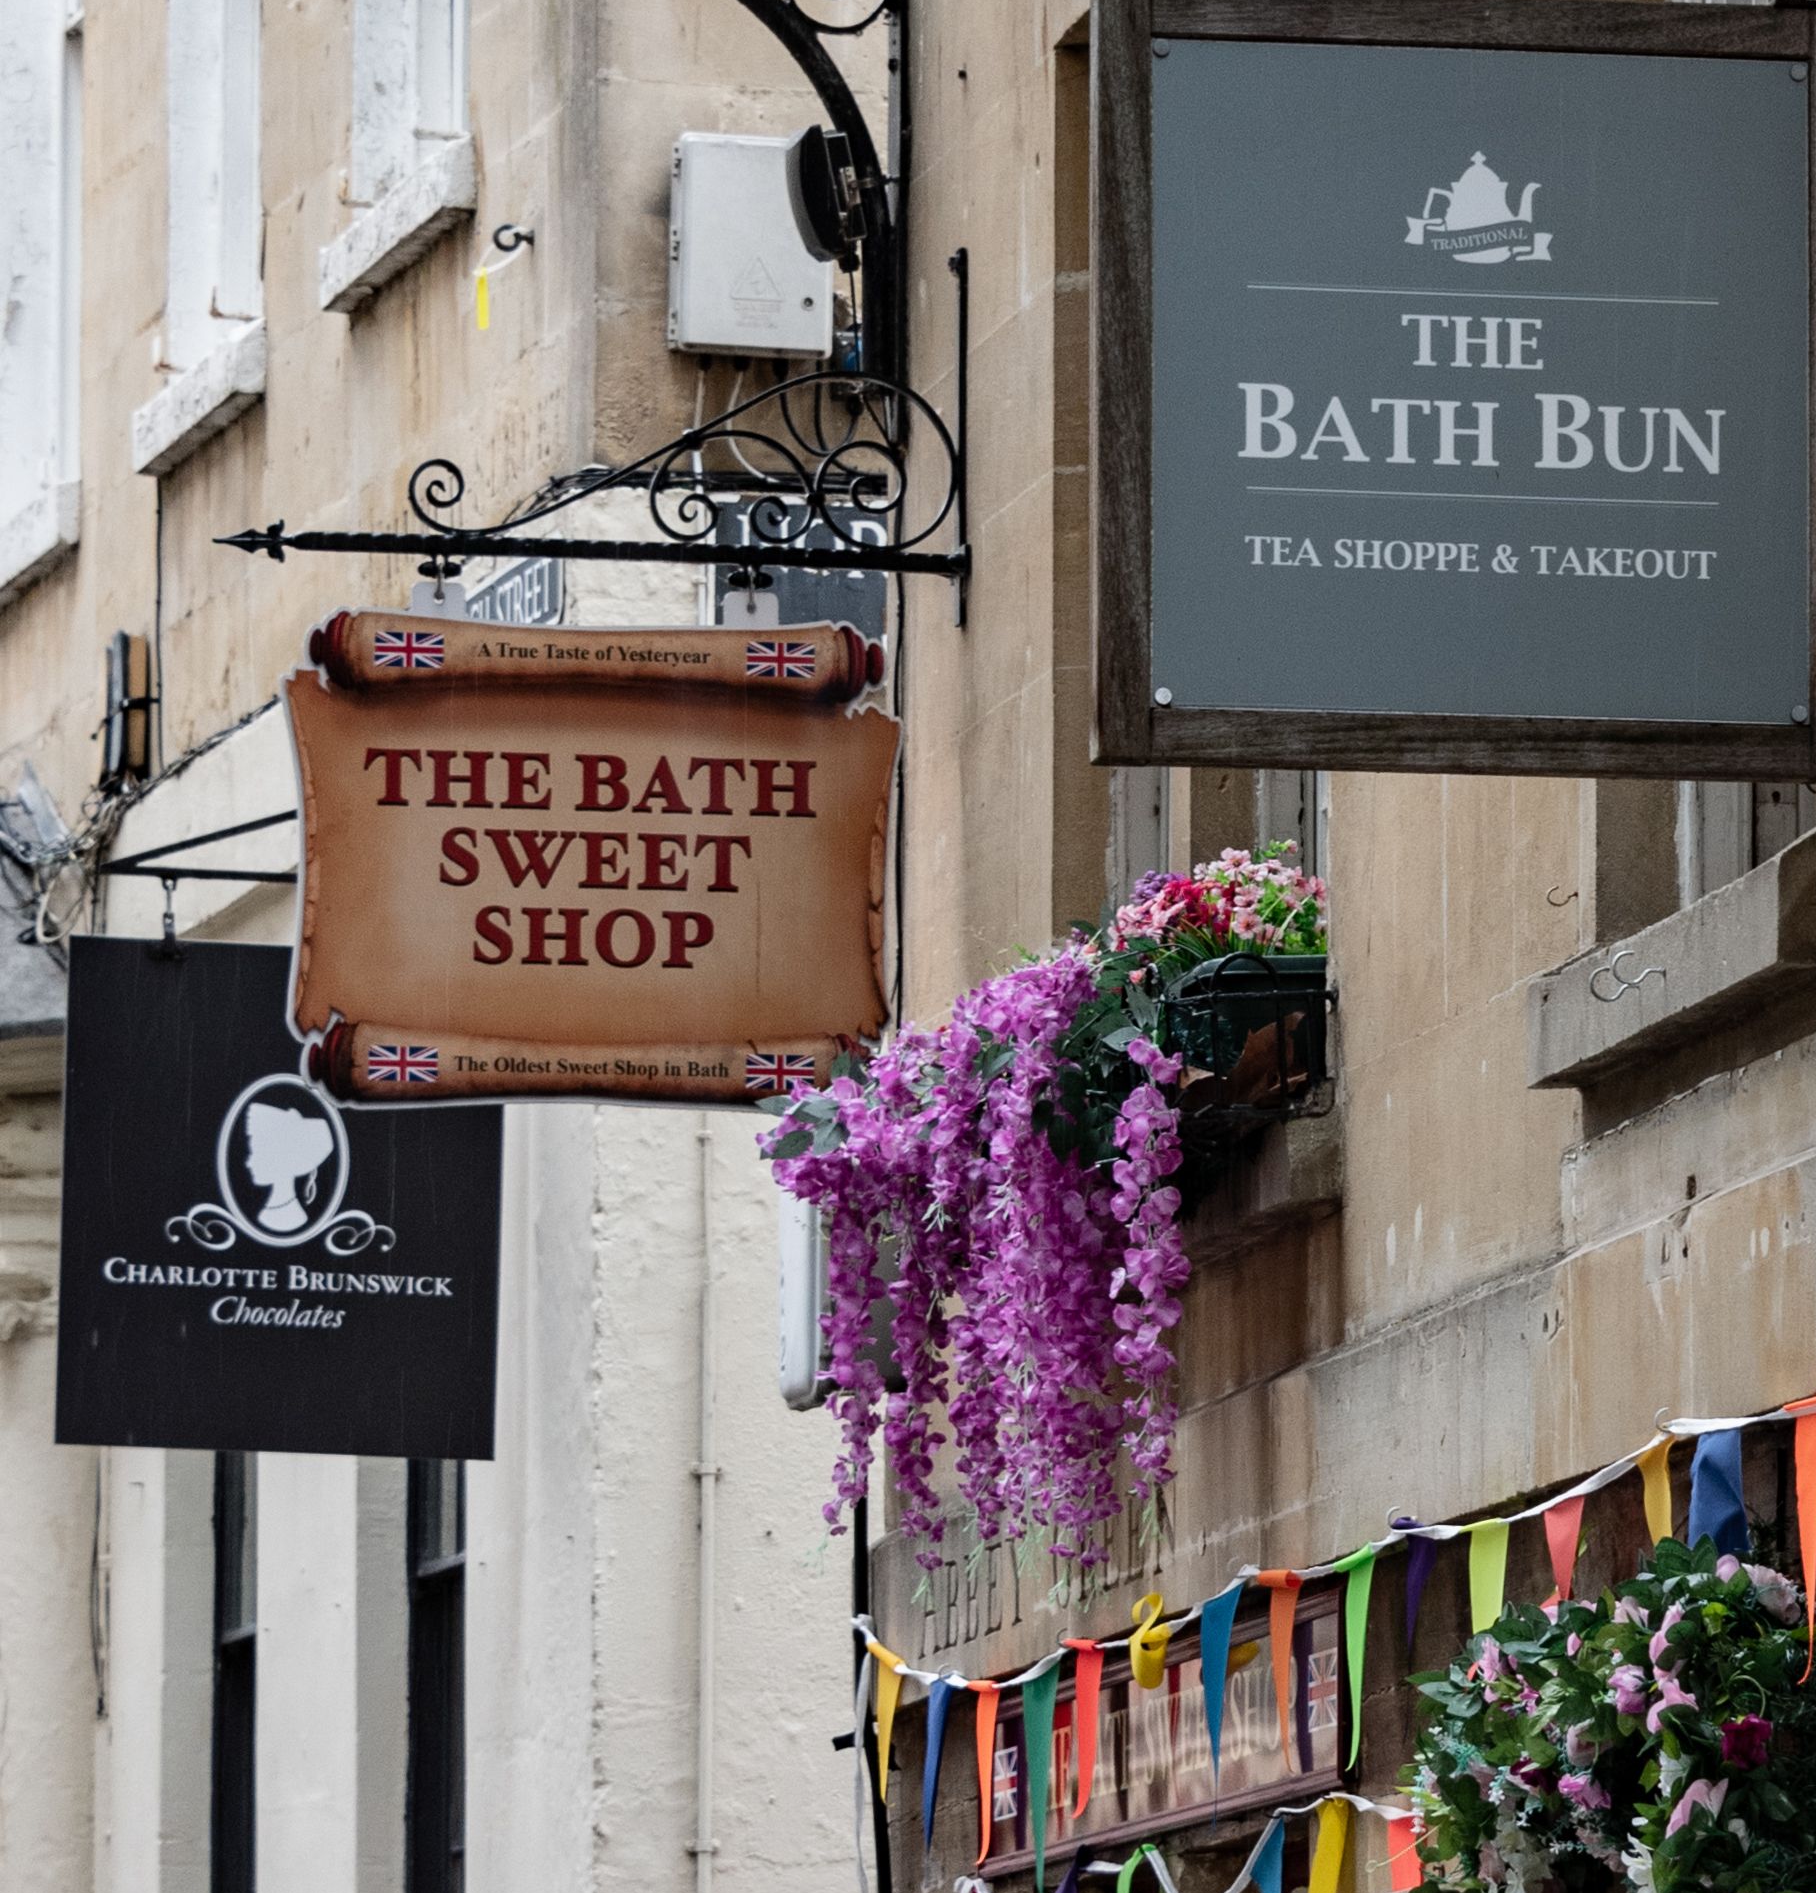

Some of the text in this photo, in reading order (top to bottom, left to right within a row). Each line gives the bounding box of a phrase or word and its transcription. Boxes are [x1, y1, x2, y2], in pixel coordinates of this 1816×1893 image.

[1430, 227, 1528, 251] TRADITIONAL
[1401, 313, 1544, 370] THE
[1237, 381, 1727, 476] BATH BUN
[1244, 535, 1718, 581] TEA SHOPPE & TAKEOUT
[477, 642, 712, 666] A True Taste of Yesteryear
[363, 747, 818, 818] THE BATH
[438, 826, 752, 894] SWEET
[472, 904, 716, 969] SHOP
[454, 1055, 730, 1081] The Oldest Sweet Shop in Bath
[103, 1256, 454, 1297] CHARLOTTE BRUNSWICK
[210, 1296, 346, 1328] Chocolates
[1143, 1679, 1222, 1787] SWEE
